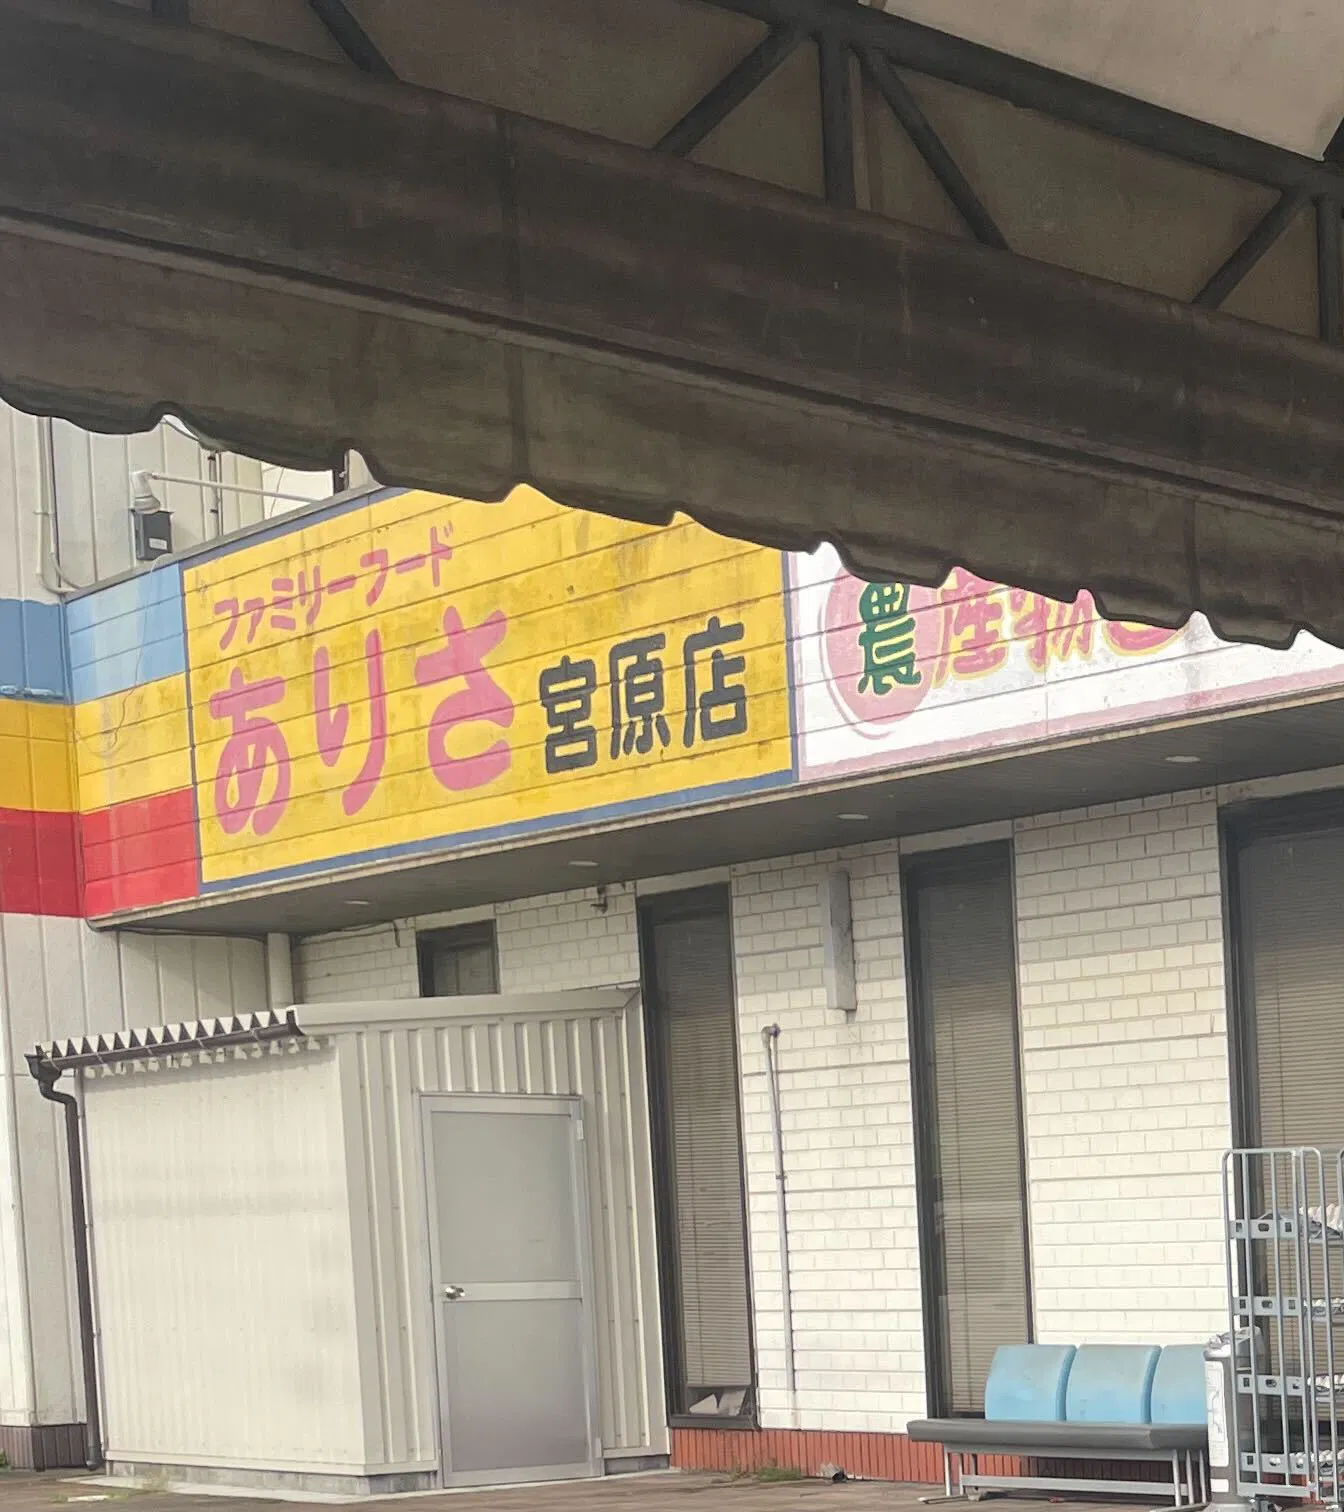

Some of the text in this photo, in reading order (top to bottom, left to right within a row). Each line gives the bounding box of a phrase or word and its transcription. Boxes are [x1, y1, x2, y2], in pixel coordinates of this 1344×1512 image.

[212, 519, 457, 652] ファミリーフード
[209, 604, 517, 836] ありさ
[537, 615, 747, 775] 宮原店
